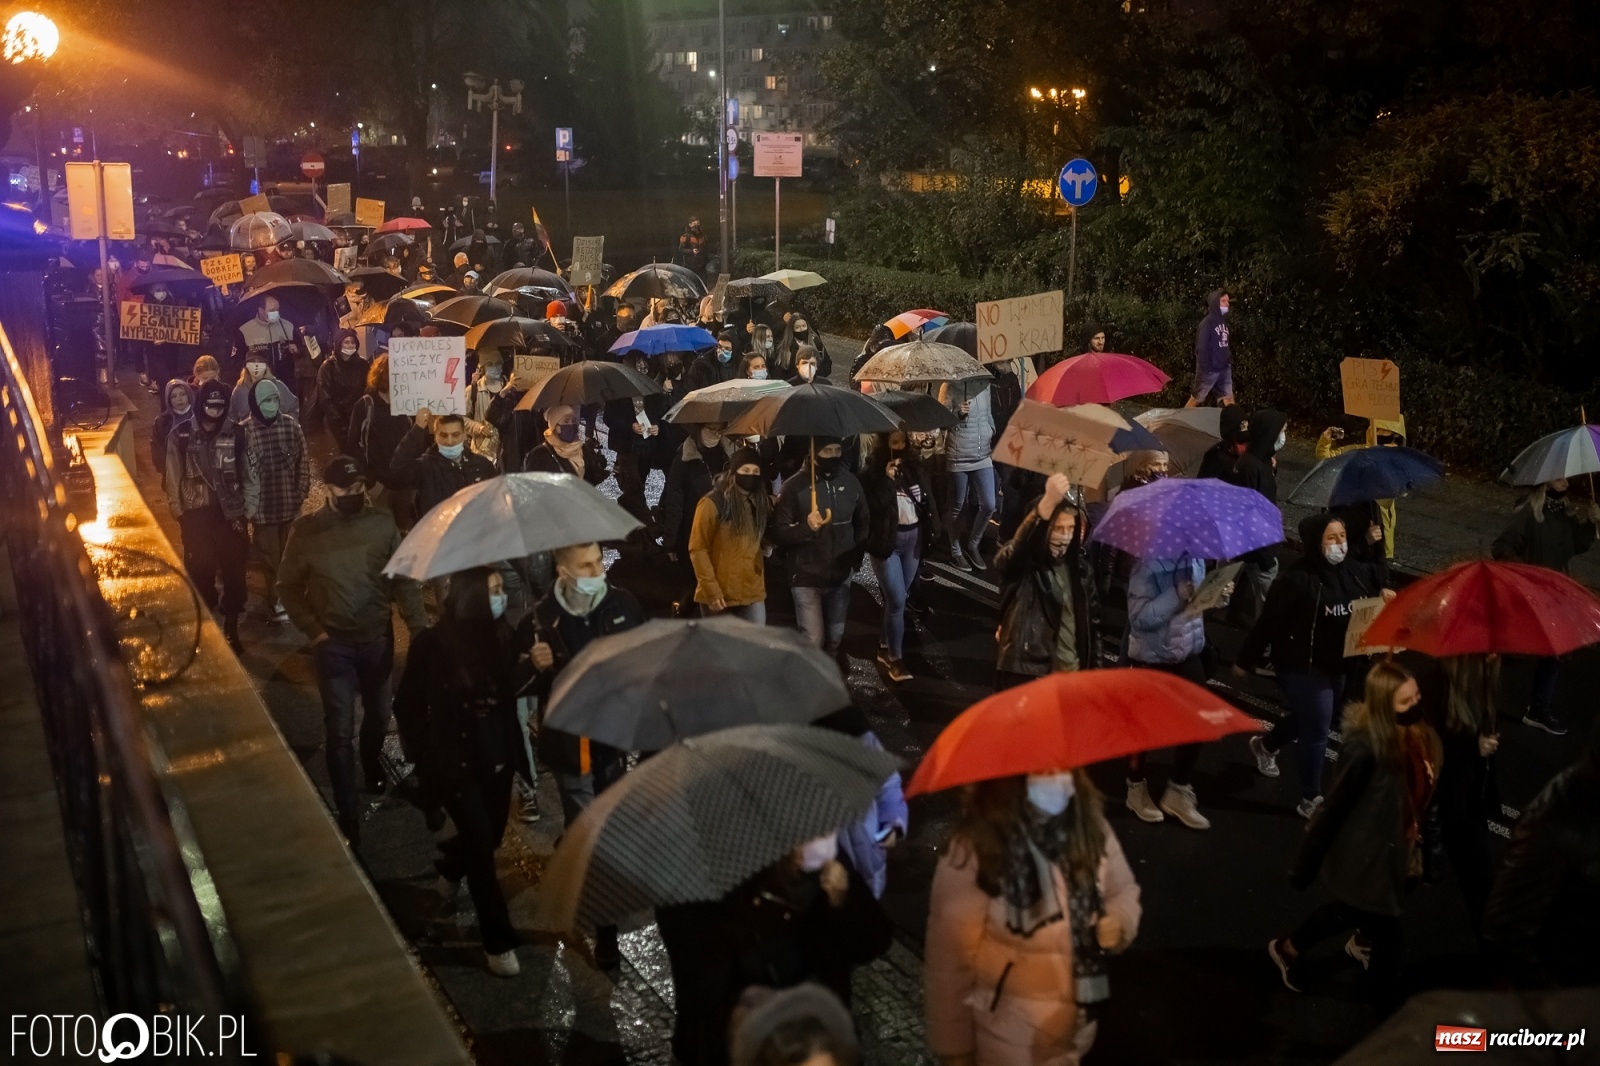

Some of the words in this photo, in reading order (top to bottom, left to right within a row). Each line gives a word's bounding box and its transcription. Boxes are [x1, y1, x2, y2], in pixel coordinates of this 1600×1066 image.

[559, 130, 569, 148] P
[205, 264, 239, 275] DOBREM
[979, 303, 1000, 329] NO
[121, 325, 199, 344] WYPIERDALAJTE
[392, 338, 452, 353] UKRADŁEŚ
[979, 333, 1008, 361] NO
[393, 353, 442, 368] KSIĘŻYC
[391, 372, 409, 383] TO
[411, 369, 437, 381] TAM
[395, 397, 458, 414] UCIEKAJ
